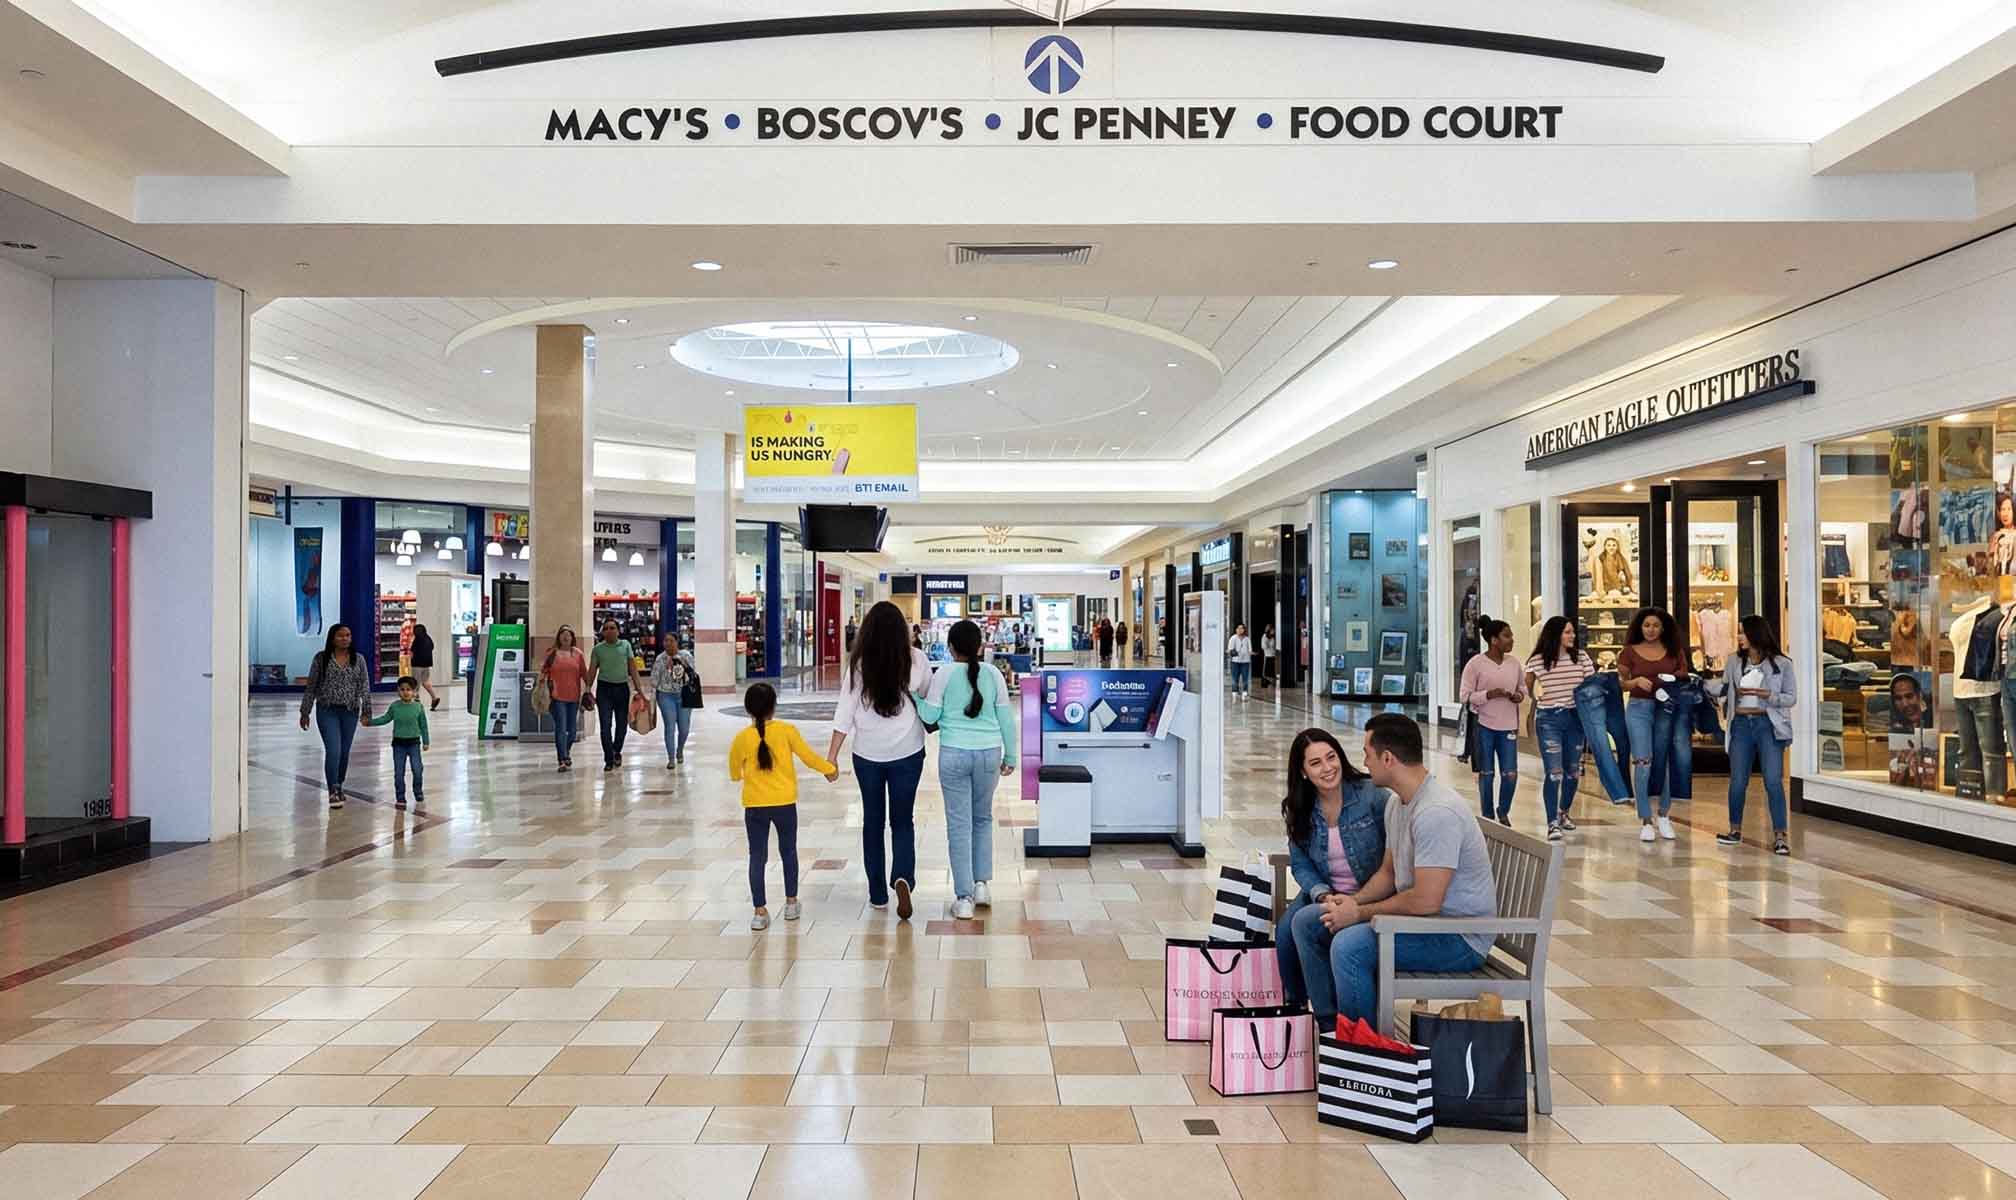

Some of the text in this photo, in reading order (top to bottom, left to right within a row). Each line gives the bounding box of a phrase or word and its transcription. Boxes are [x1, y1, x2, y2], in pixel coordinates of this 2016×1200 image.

[545, 106, 1563, 141] MACY'S BOSCOV'S JC PENNEY FOOD COURT
[1526, 349, 1801, 459] AMERICAN EAGLE OUTFITTERS
[751, 436, 825, 448] IS MAKING
[751, 449, 769, 462] US
[875, 483, 909, 493] EMAIL
